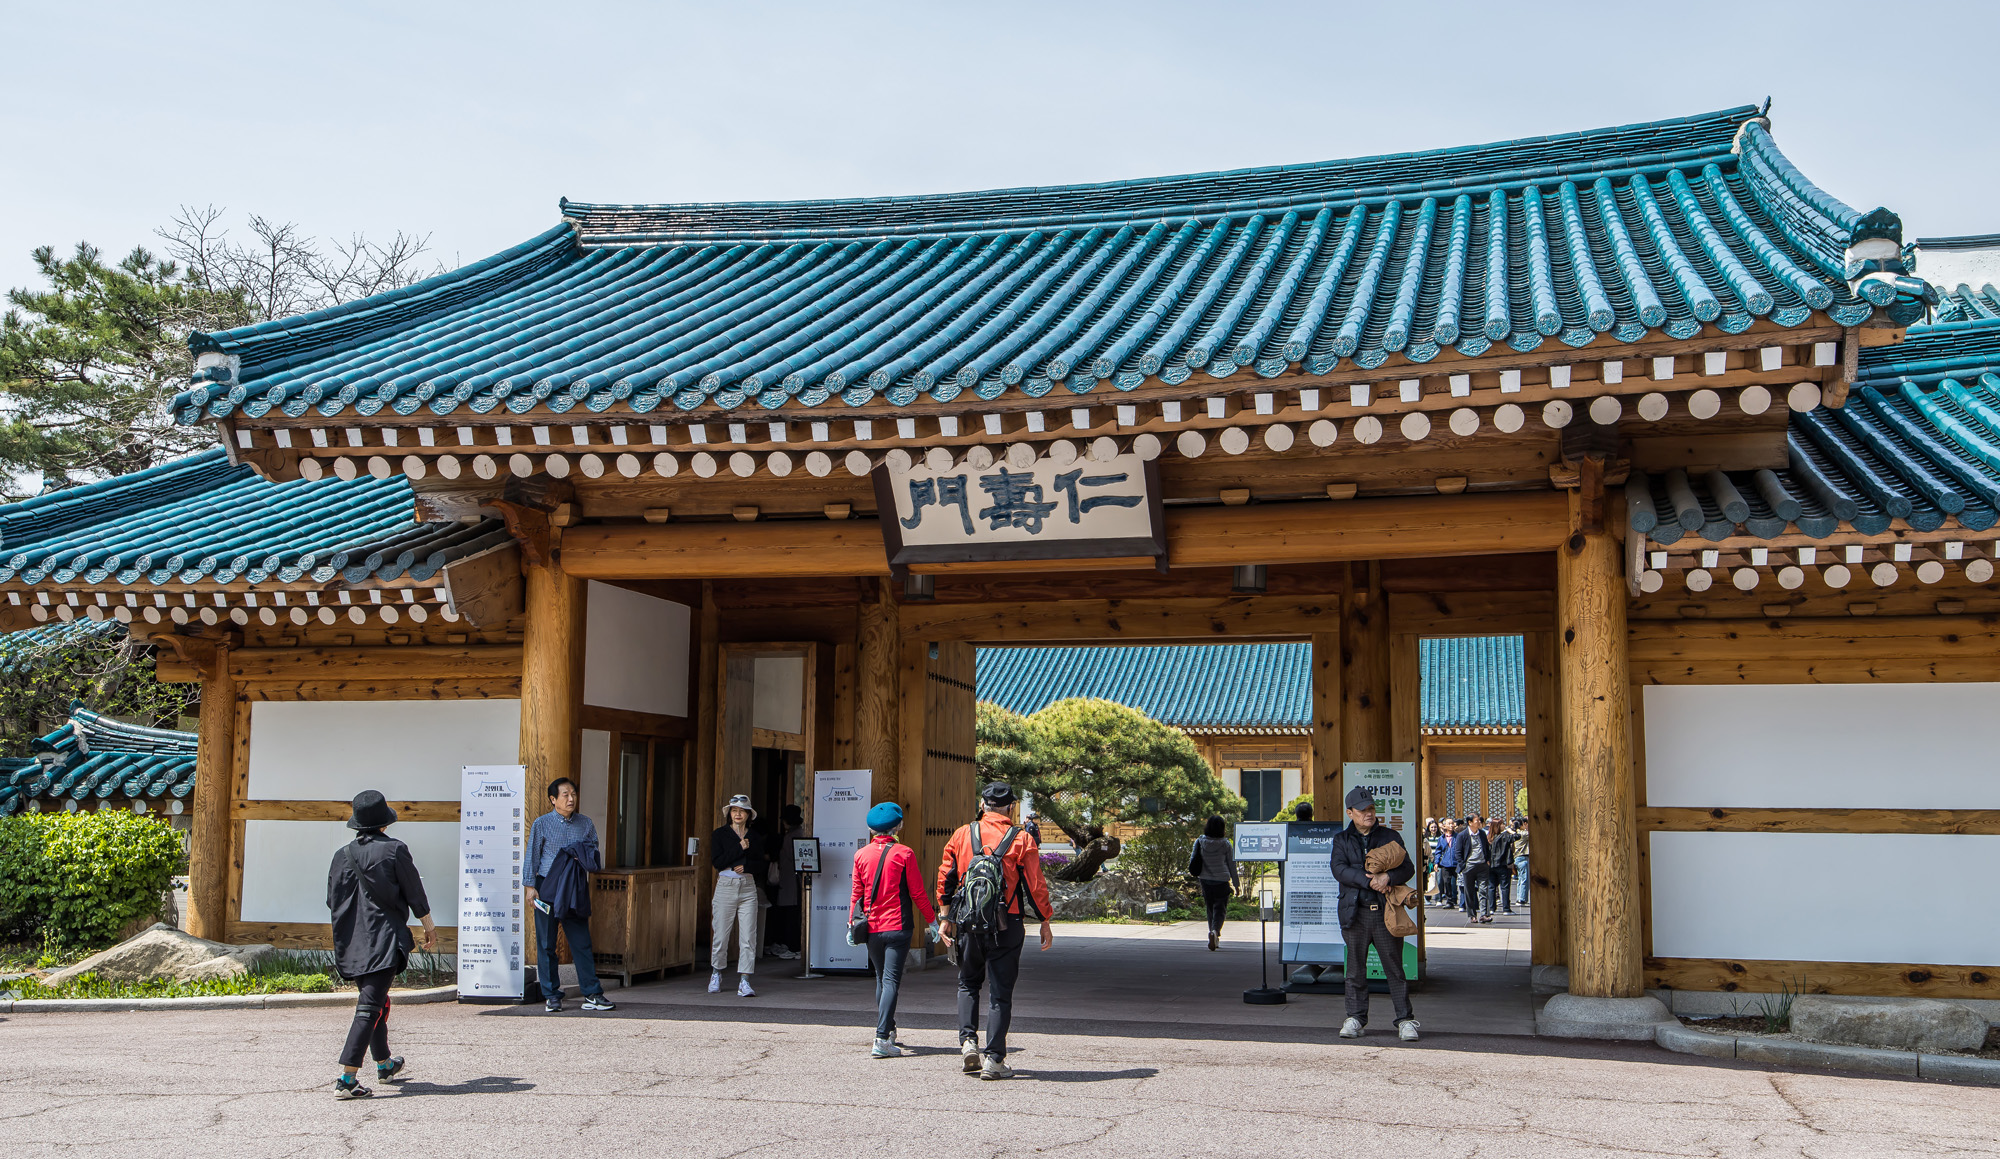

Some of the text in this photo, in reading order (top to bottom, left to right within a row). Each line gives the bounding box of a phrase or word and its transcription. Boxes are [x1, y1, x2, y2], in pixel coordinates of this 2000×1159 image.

[1355, 785, 1402, 796] 와대의
[1241, 837, 1280, 847] 입구 출구
